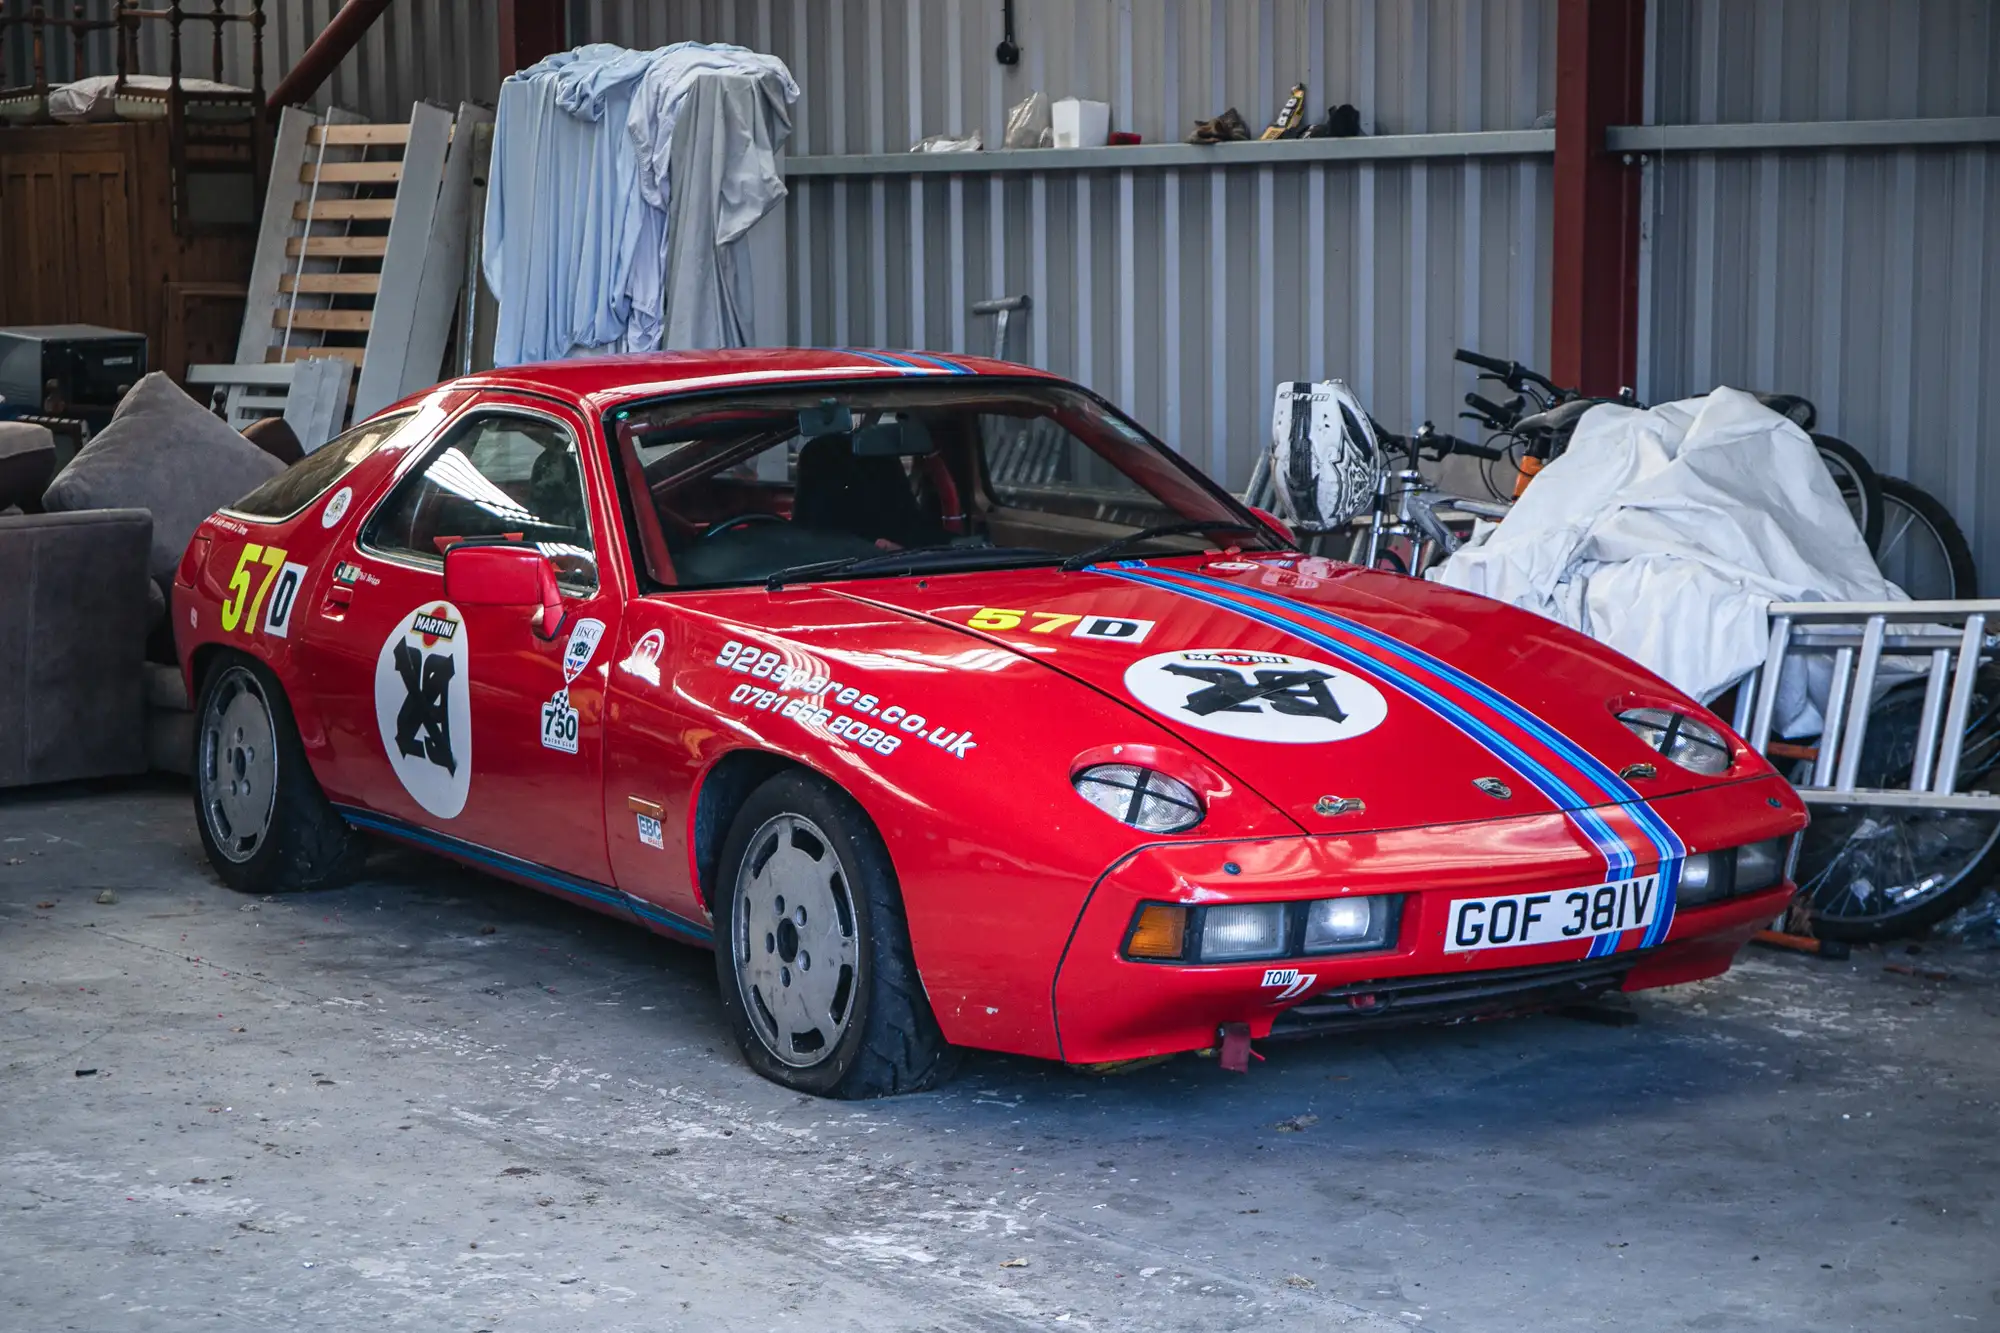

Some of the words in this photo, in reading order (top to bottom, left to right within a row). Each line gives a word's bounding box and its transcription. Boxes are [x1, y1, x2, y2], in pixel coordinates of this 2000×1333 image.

[414, 614, 456, 638] MARTINI
[575, 625, 600, 641] HSCC
[1183, 652, 1290, 664] MARTINI
[714, 639, 978, 760] 928spares.co.uk
[544, 709, 577, 741] 750
[638, 815, 661, 840] EBC
[1455, 894, 1552, 947] GOF
[1561, 878, 1657, 936] 381V
[1265, 970, 1296, 985] TOW
